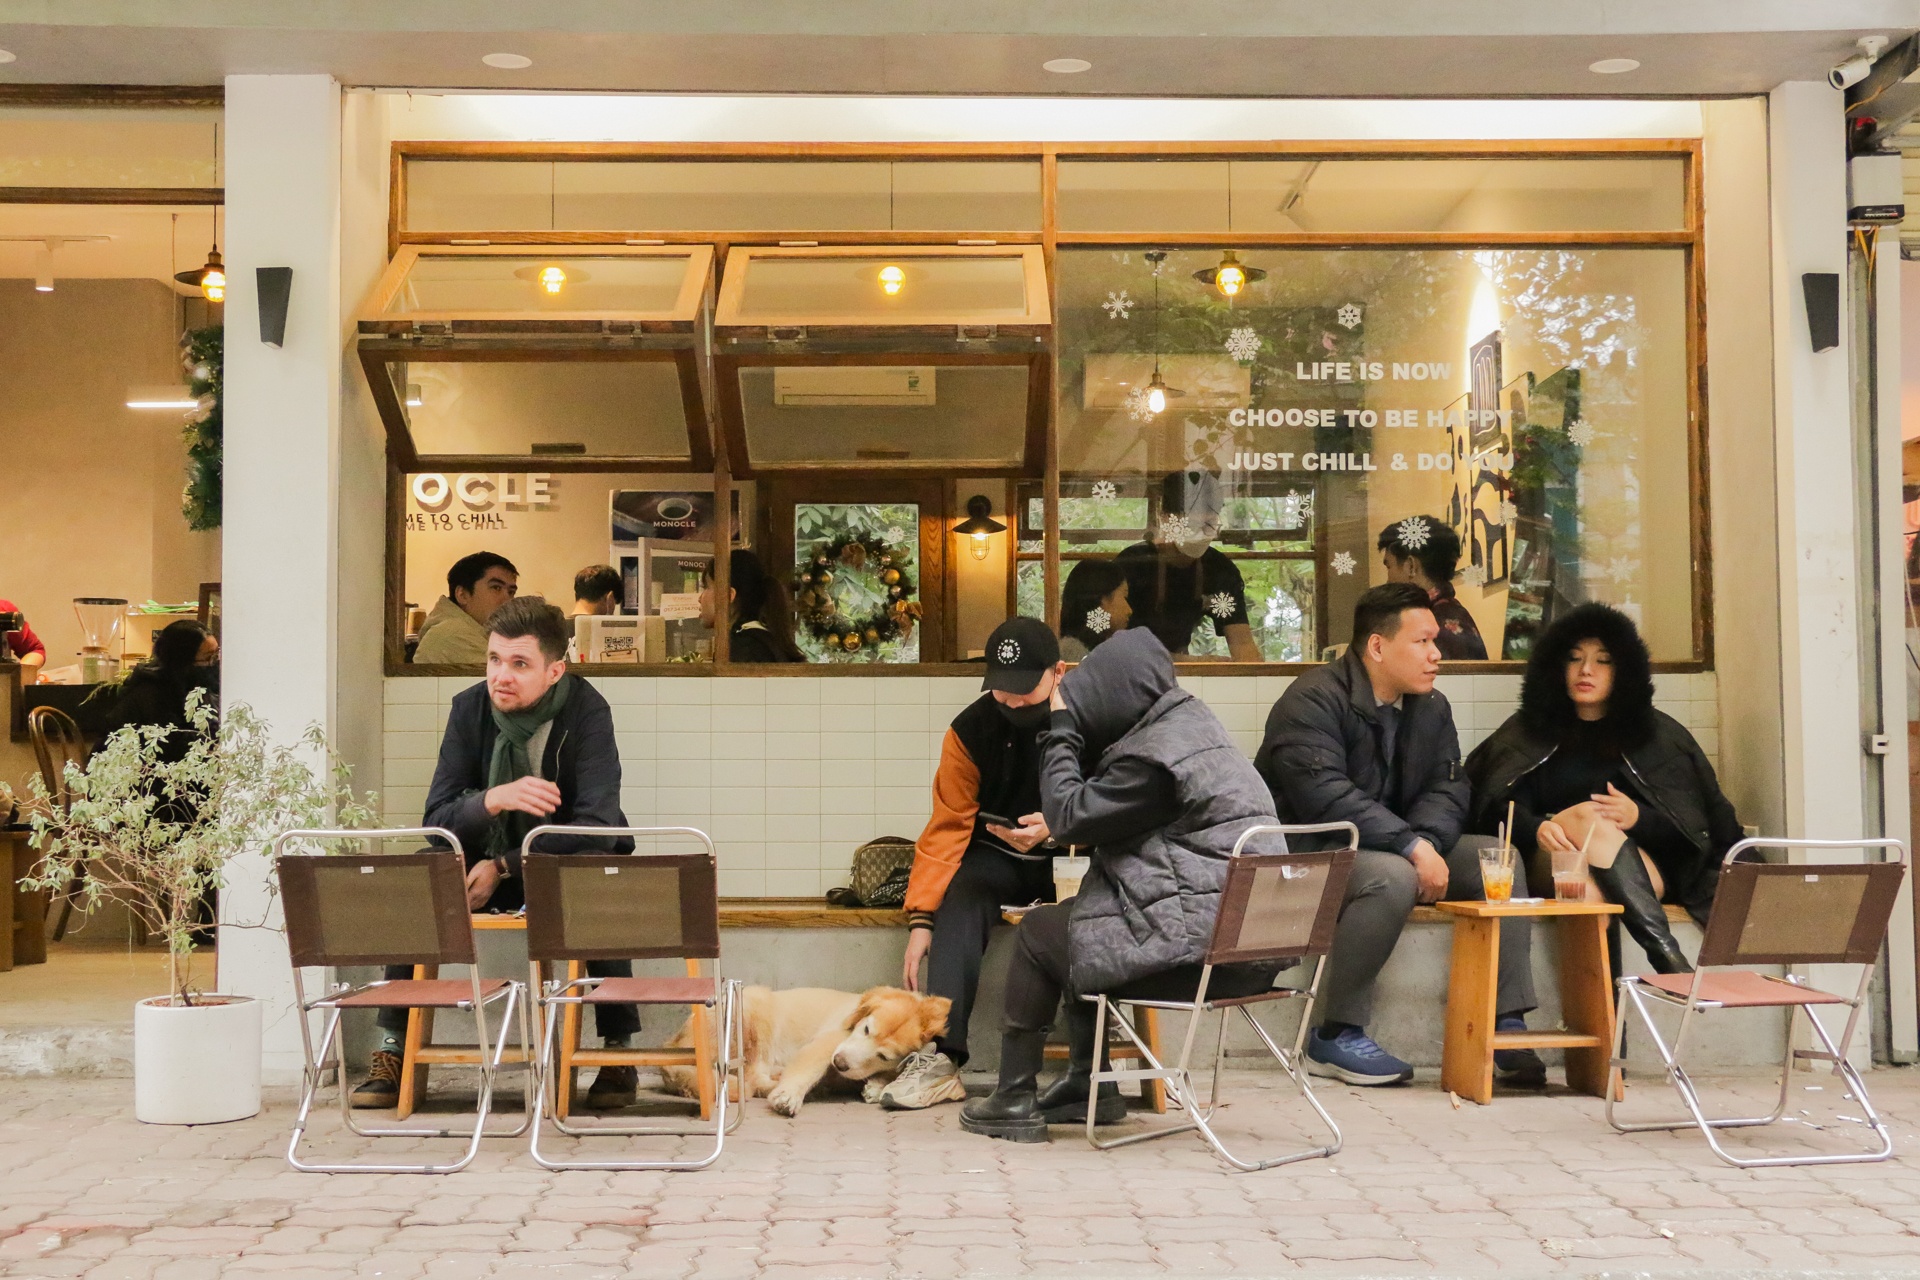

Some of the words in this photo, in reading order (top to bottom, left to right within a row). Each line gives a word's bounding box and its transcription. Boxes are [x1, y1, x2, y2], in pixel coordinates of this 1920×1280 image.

[1296, 362, 1351, 380] LIFE
[1359, 362, 1384, 380] IS
[1392, 362, 1451, 380] NOW
[1229, 409, 1336, 427] CHOOSE
[1344, 409, 1378, 427] TO
[1385, 409, 1419, 427] BE
[1427, 409, 1513, 427] HAPPY
[1227, 453, 1294, 471] JUST
[1302, 453, 1377, 471] CHILL
[1390, 453, 1409, 471] &
[1417, 453, 1453, 471] DO
[1460, 453, 1514, 471] YOU
[430, 513, 450, 523] TO
[458, 513, 503, 523] CHILL
